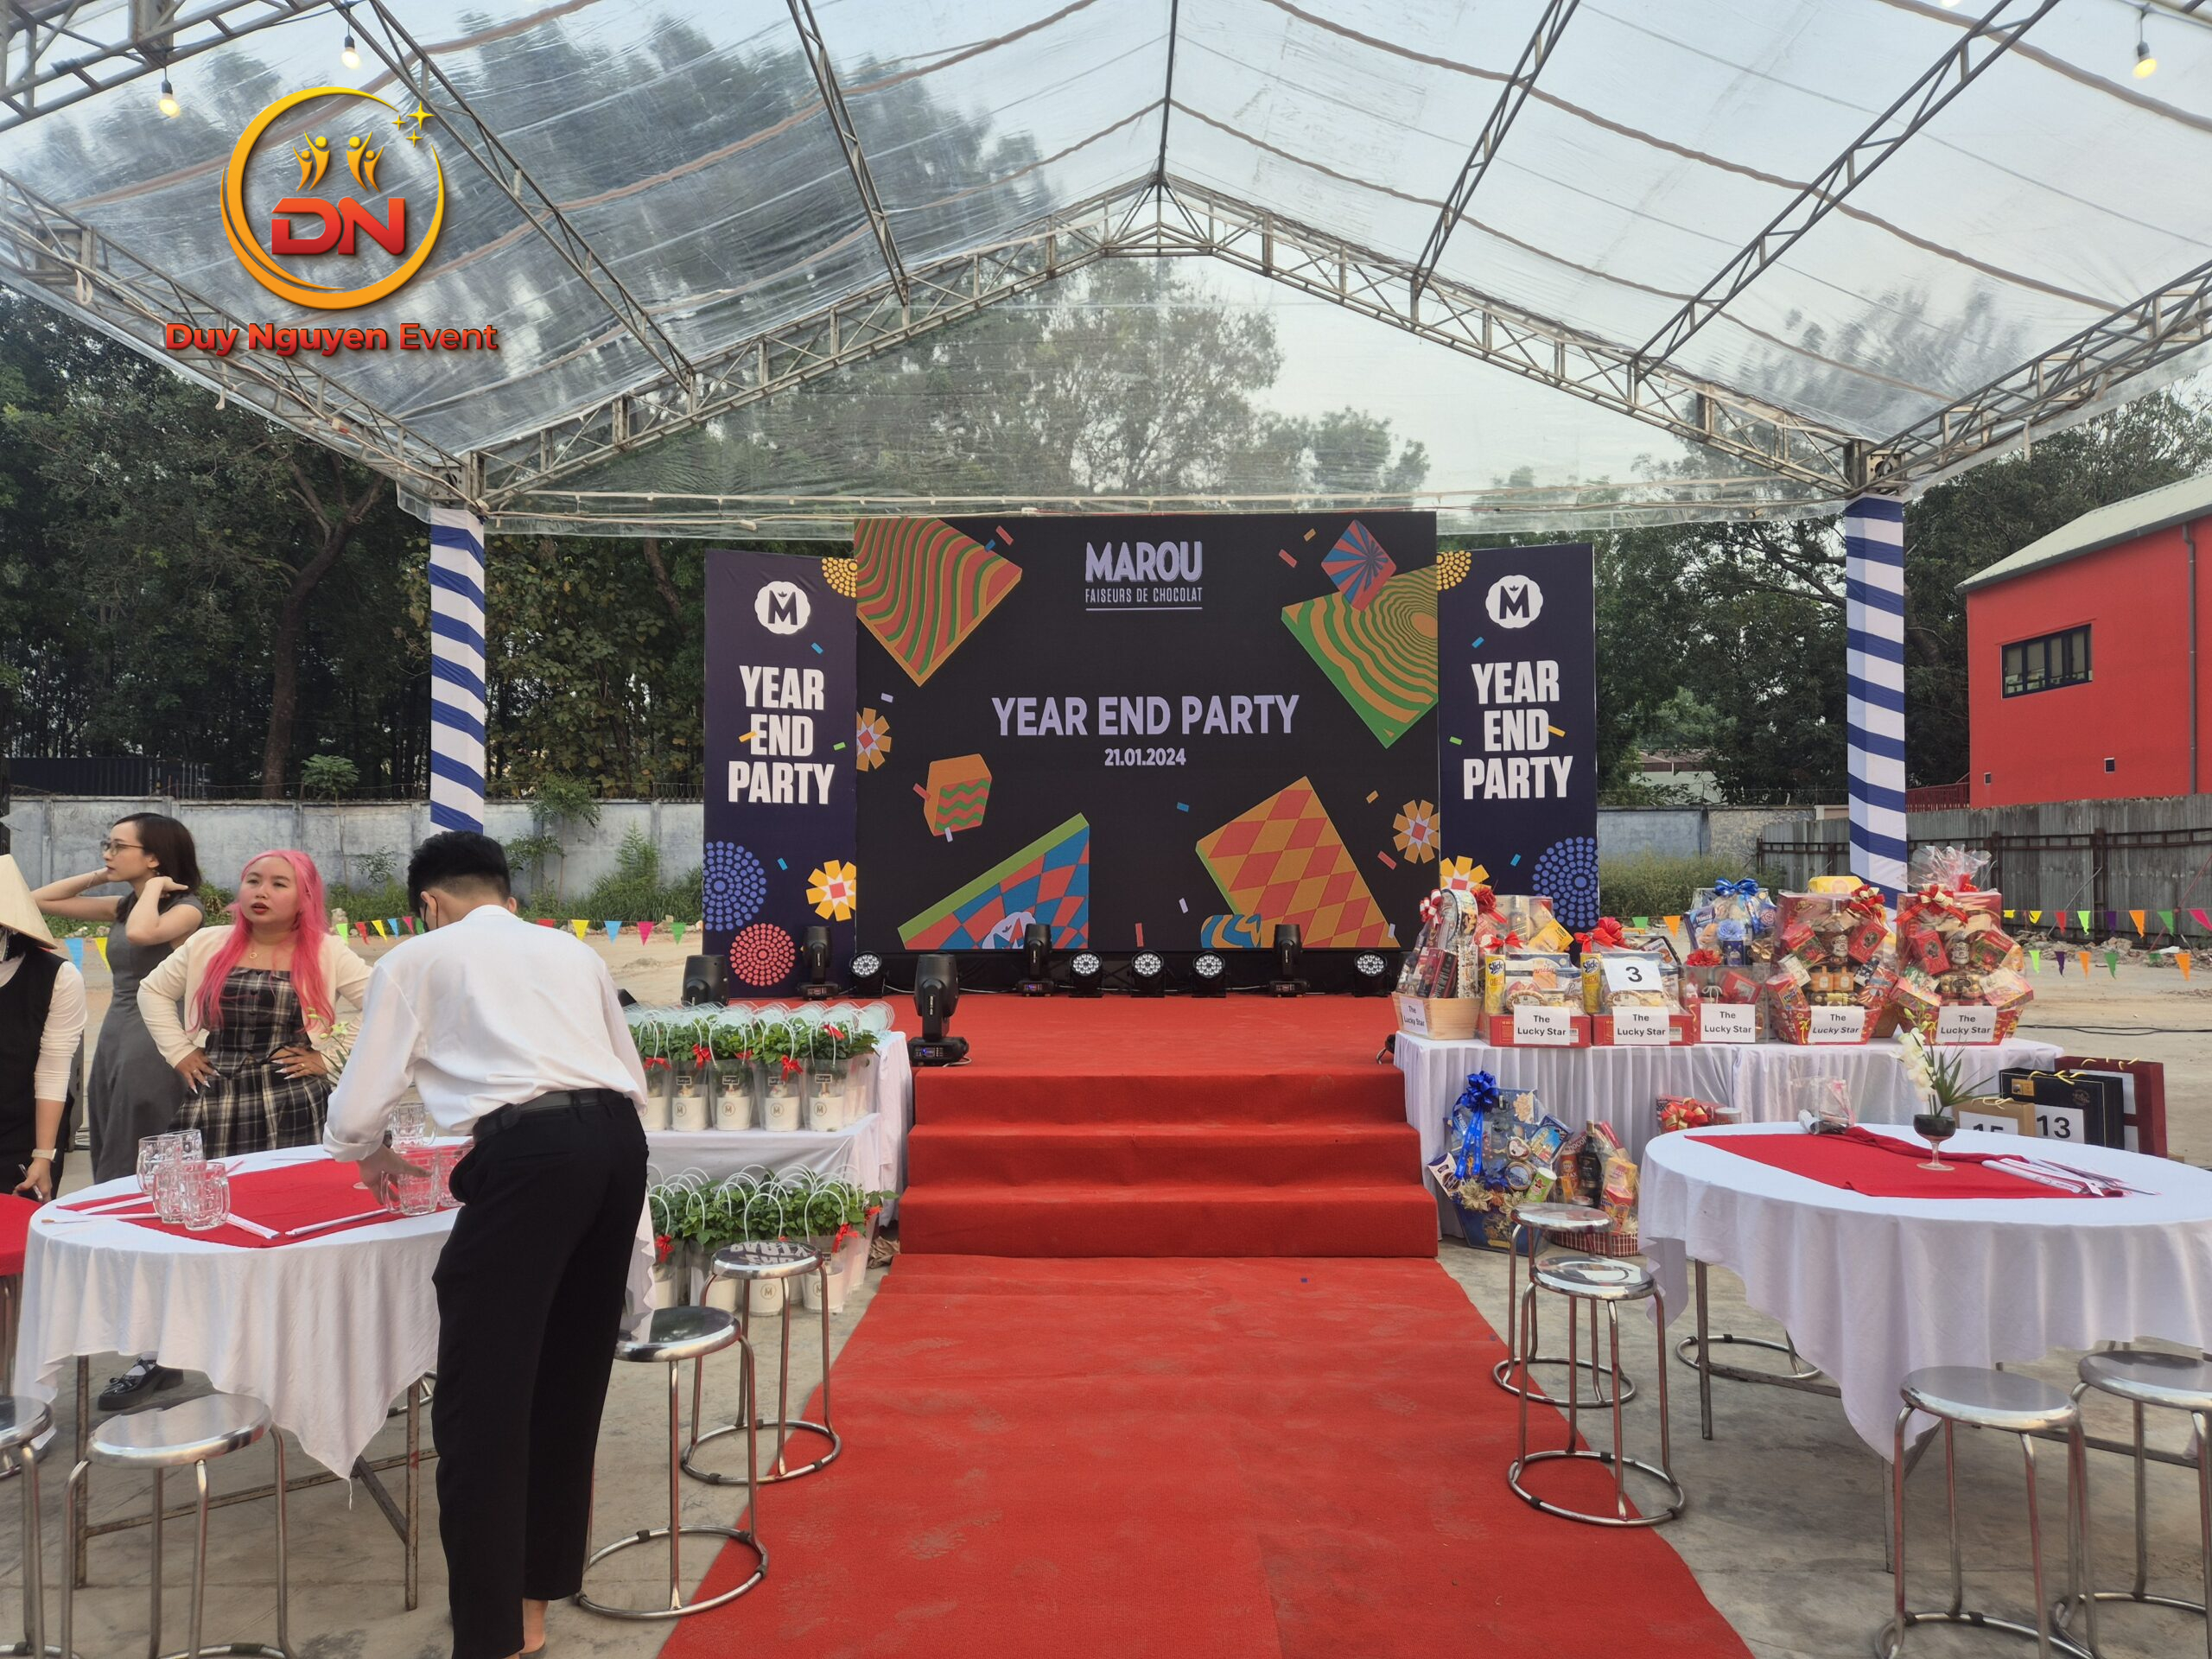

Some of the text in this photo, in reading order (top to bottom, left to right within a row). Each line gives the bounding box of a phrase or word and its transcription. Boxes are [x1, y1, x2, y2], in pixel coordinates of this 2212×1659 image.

[1084, 541, 1202, 582] MAROU
[1084, 587, 1202, 603] FAISEURS DE CHOCOLAT
[739, 664, 824, 710] YEAR
[1471, 660, 1560, 704] YEAR
[992, 694, 1300, 736] YEAR END PARTY
[749, 713, 814, 756] END
[1484, 709, 1549, 752] END
[1103, 747, 1187, 766] 21.01.2024
[728, 761, 835, 805] PARTY
[1463, 756, 1573, 800] PARTY
[1625, 966, 1643, 982] 3
[1408, 1005, 1417, 1014] The
[1403, 1015, 1425, 1027] Lucky Star
[1533, 1014, 1550, 1023] The
[1632, 1014, 1649, 1022] The
[1958, 1014, 1976, 1023] The
[1517, 1027, 1567, 1037] Lucky Star
[1617, 1027, 1666, 1037] Lucky Star
[1704, 1025, 1752, 1034] Lucky Star
[1812, 1026, 1859, 1035] Lucky Star
[1940, 1027, 1969, 1035] Lucky
[2036, 1115, 2071, 1139] 13
